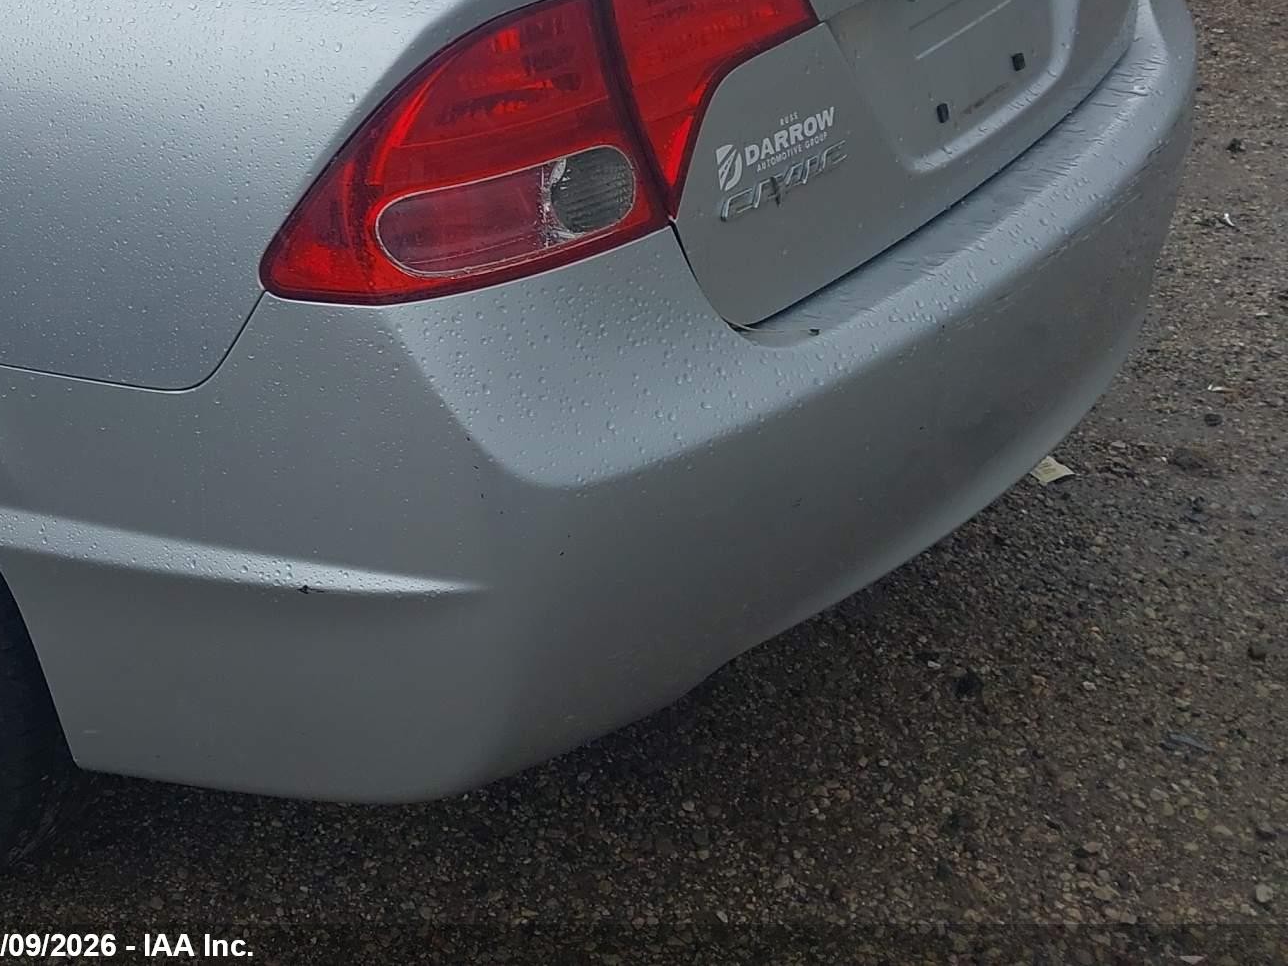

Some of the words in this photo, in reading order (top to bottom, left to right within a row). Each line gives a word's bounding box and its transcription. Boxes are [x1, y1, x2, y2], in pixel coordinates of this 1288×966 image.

[744, 106, 835, 166] DARROW
[756, 144, 803, 173] AUTOMOTIVE
[805, 131, 828, 150] GROUP
